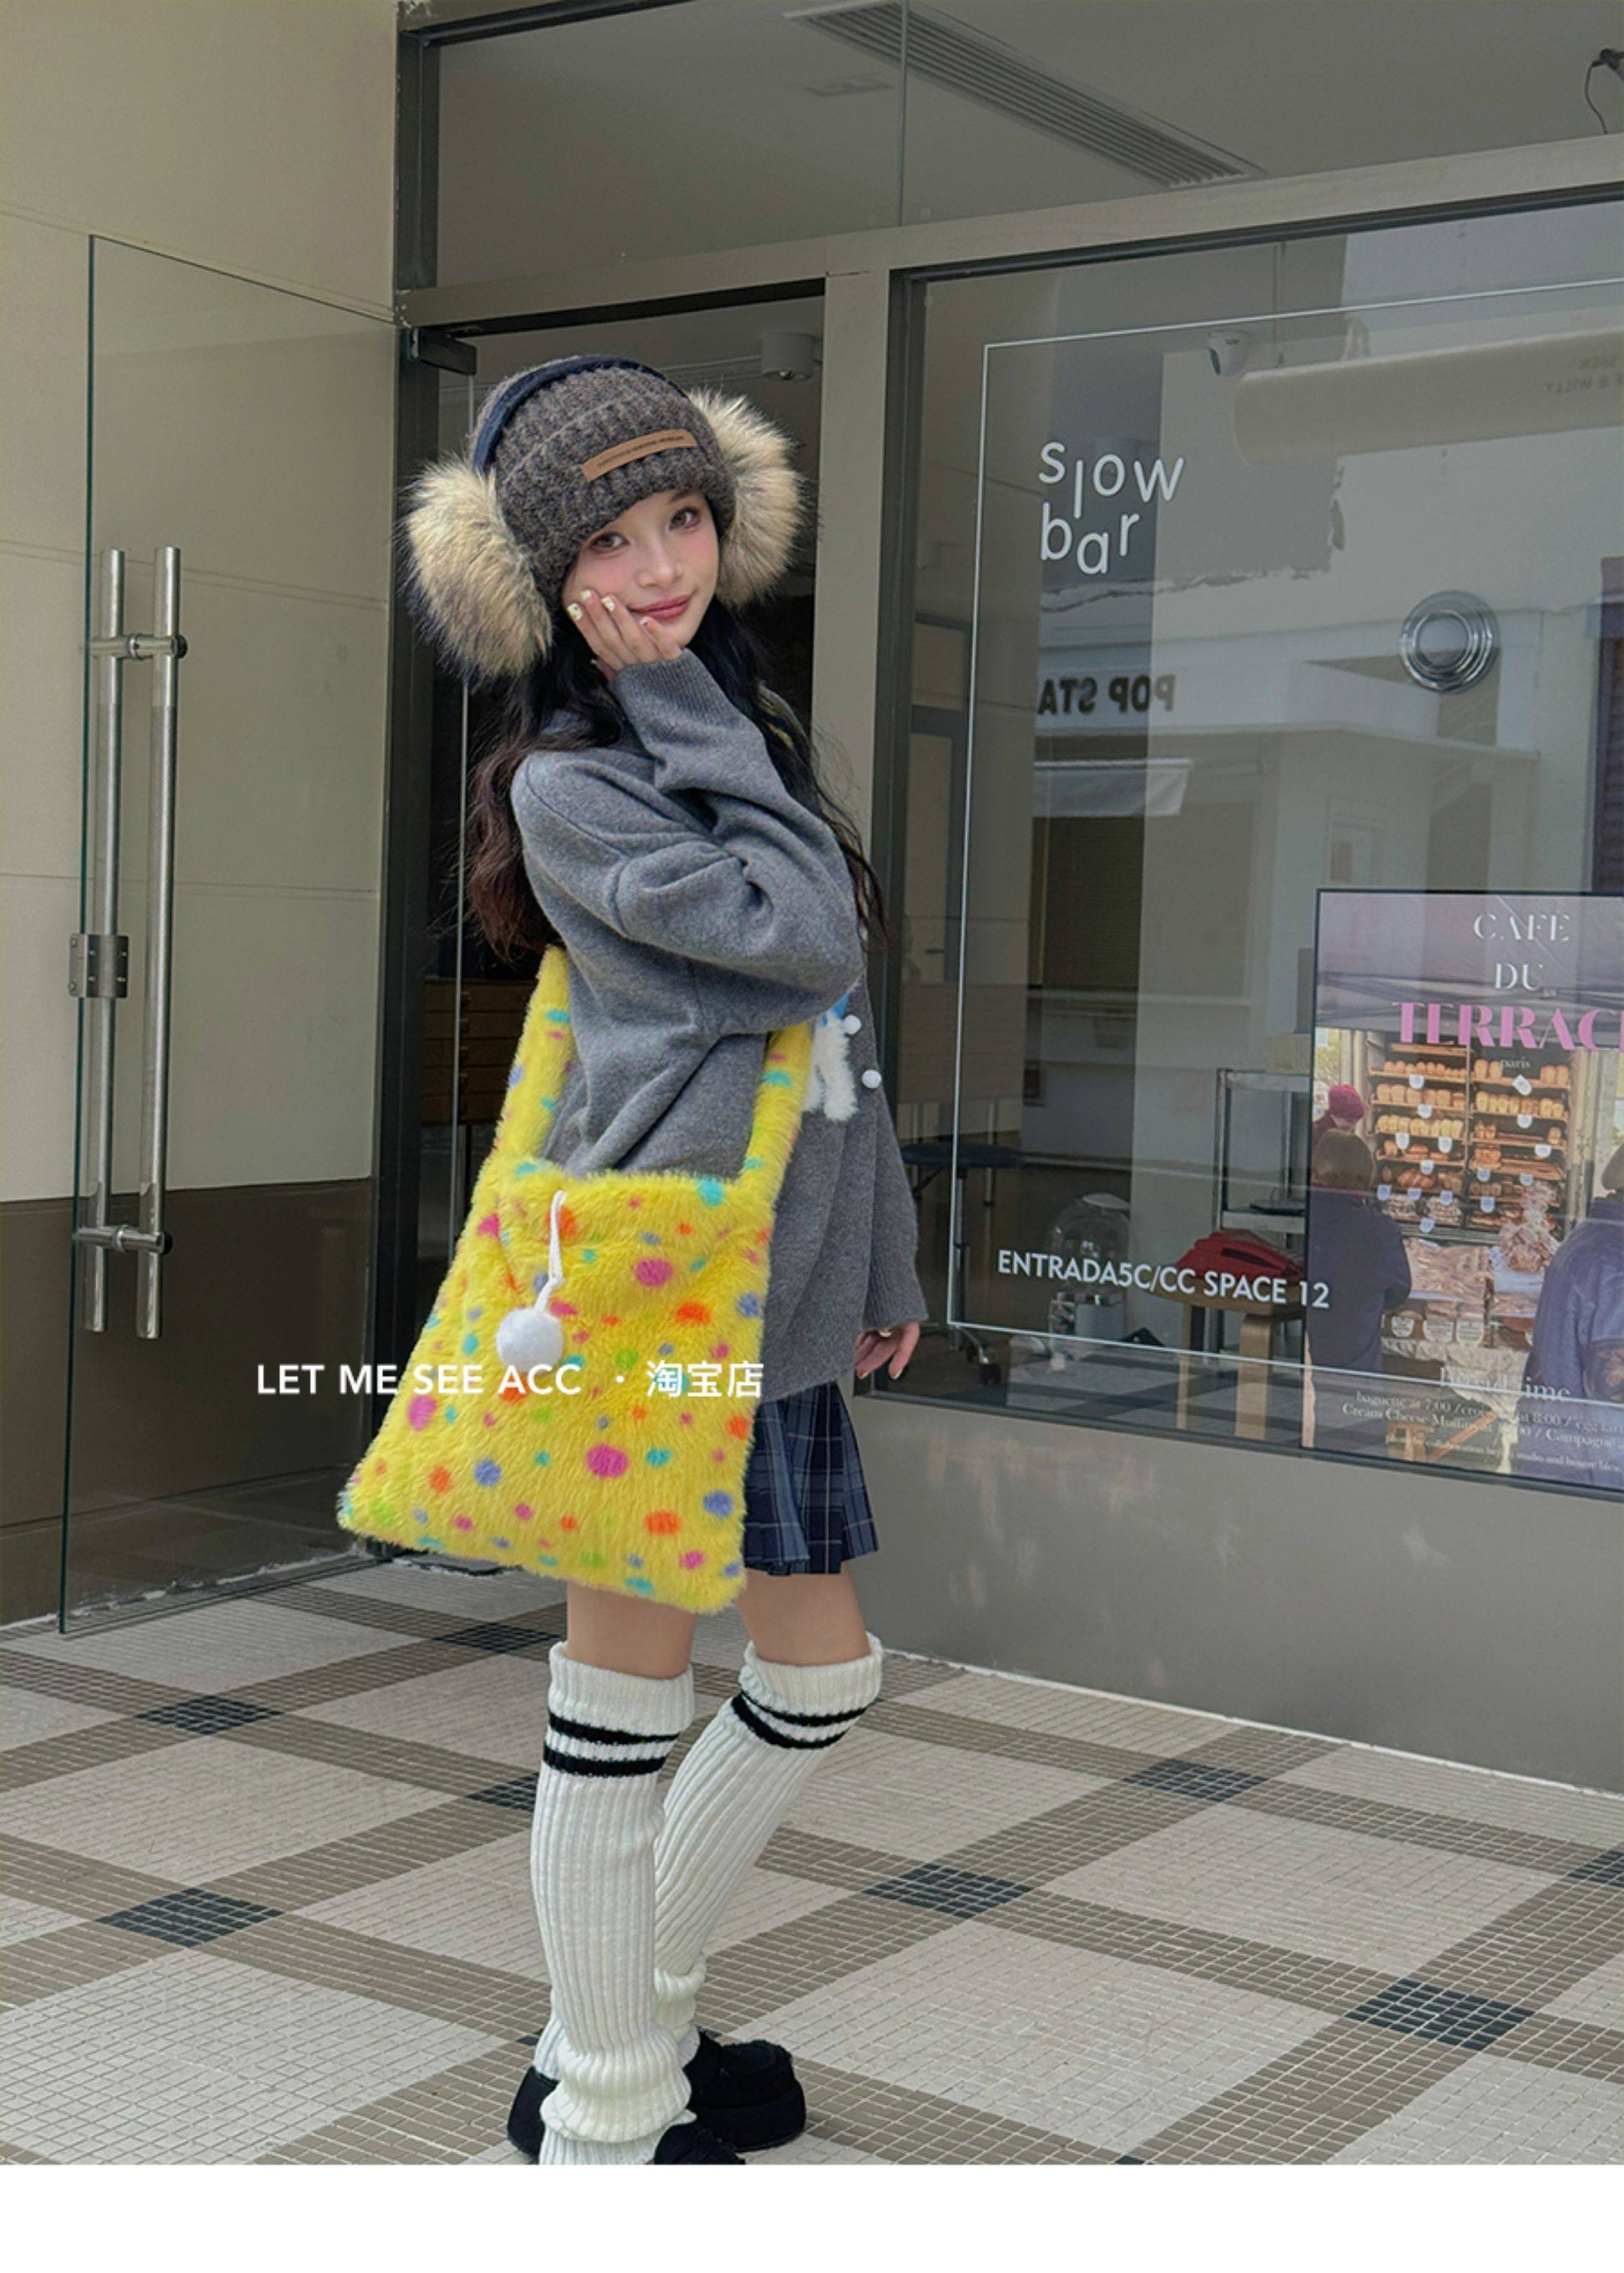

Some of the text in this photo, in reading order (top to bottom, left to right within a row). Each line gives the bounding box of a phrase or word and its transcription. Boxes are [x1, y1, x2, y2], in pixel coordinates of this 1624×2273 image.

[1039, 441, 1184, 519] slow
[1041, 502, 1139, 574] bar
[1495, 962, 1544, 990] DU
[1391, 1002, 1624, 1051] TERRAC
[998, 1249, 1329, 1308] ENTRADA5C/CC SPACE 12
